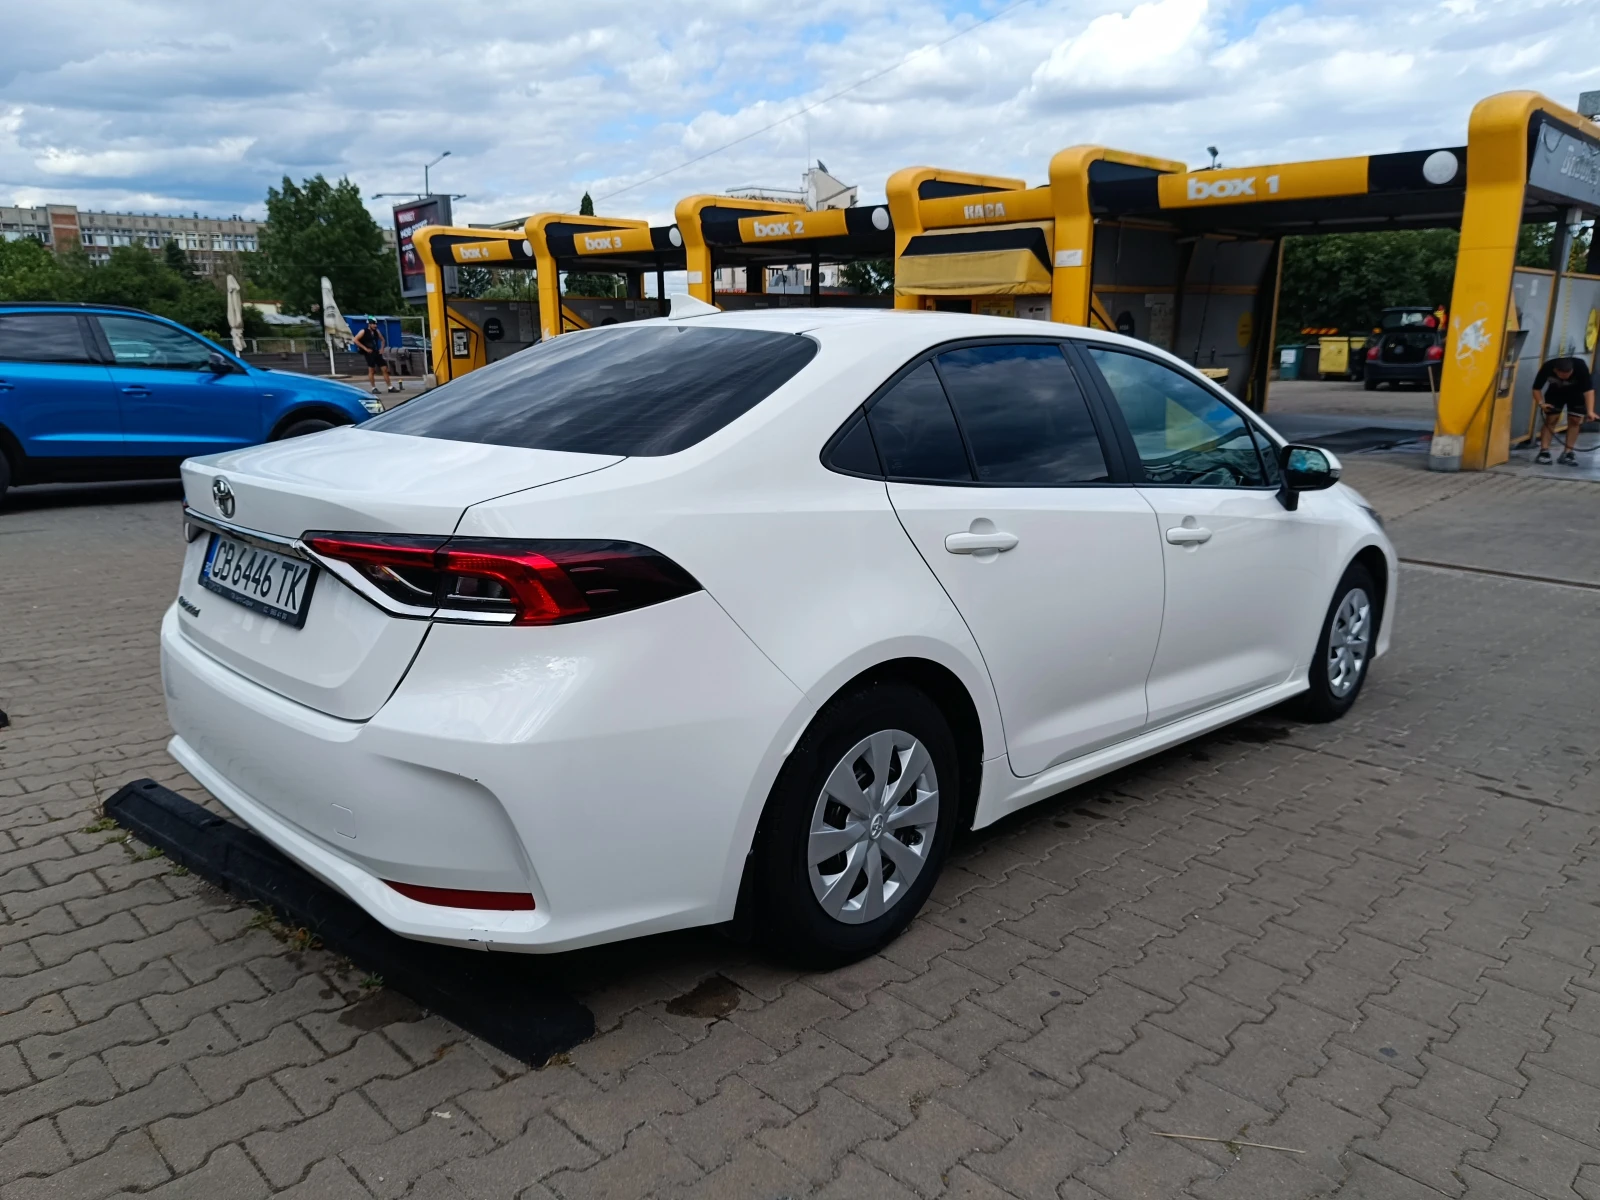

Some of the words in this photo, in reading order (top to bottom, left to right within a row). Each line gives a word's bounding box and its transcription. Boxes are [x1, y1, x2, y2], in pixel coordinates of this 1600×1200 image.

[1187, 176, 1256, 200] box
[1265, 174, 1280, 194] 1
[753, 220, 791, 238] box
[793, 219, 804, 235] 2
[584, 235, 612, 251] box
[614, 236, 622, 249] 3
[459, 246, 481, 260] box
[482, 246, 489, 258] 4
